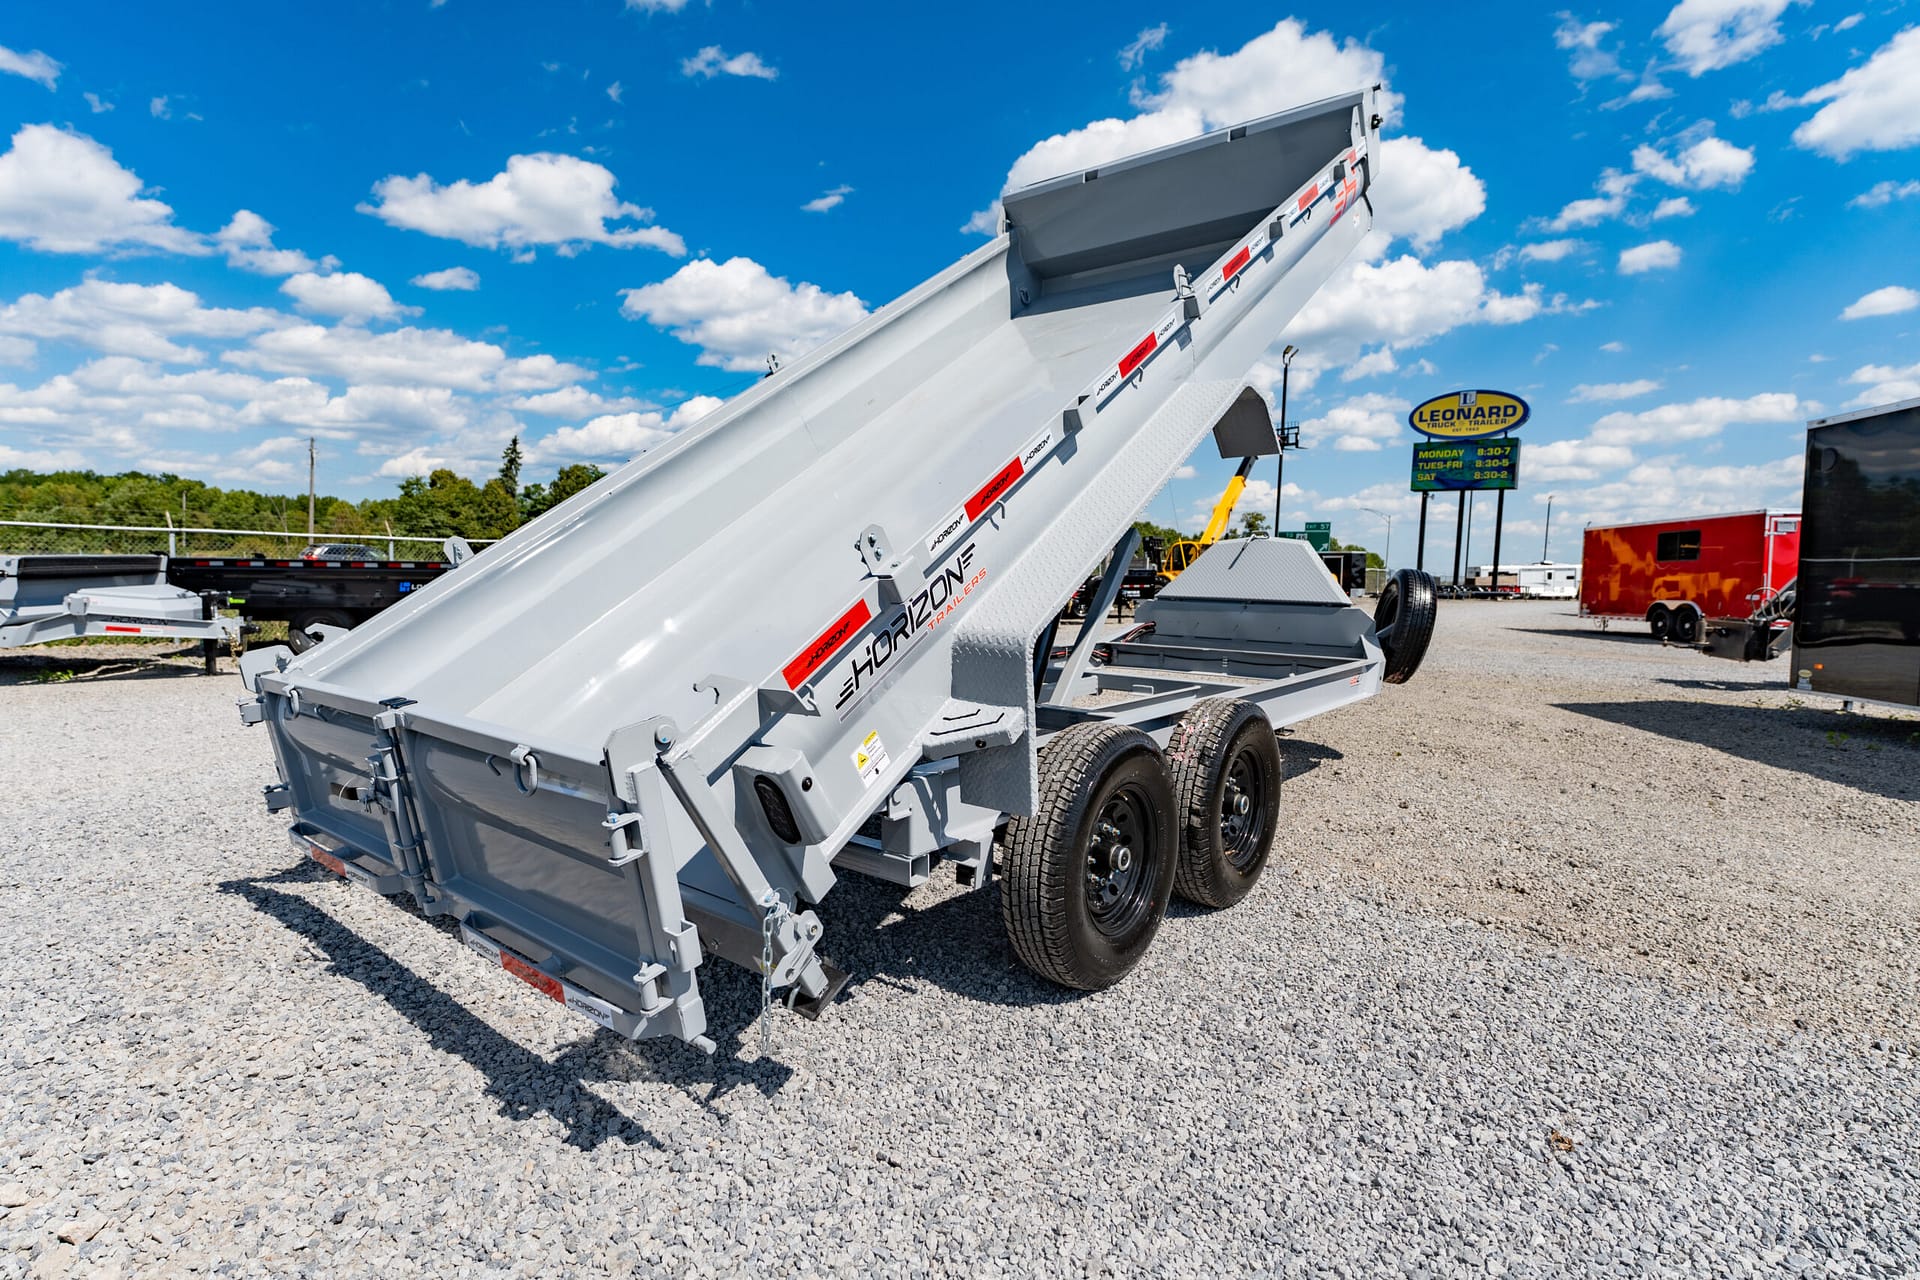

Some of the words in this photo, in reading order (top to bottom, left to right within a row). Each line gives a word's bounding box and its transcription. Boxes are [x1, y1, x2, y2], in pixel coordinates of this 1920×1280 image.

[1418, 404, 1518, 423] LEONARD
[1426, 421, 1456, 429] TRUCK
[1468, 418, 1507, 427] TRAILER
[1418, 449, 1465, 459] MONDAY
[1477, 447, 1511, 456] 8:30-7
[1418, 460, 1463, 470] TUES-FRI
[1475, 459, 1509, 468] 8:30-5
[1417, 473, 1437, 481] SAT
[1473, 471, 1508, 479] 8:30-2
[931, 513, 964, 551] HORIZON
[411, 583, 425, 591] LO
[927, 567, 987, 631] TRAILERS
[838, 545, 973, 705] HORIZON
[807, 621, 850, 668] HORIZON
[568, 996, 610, 1020] HORIZON
